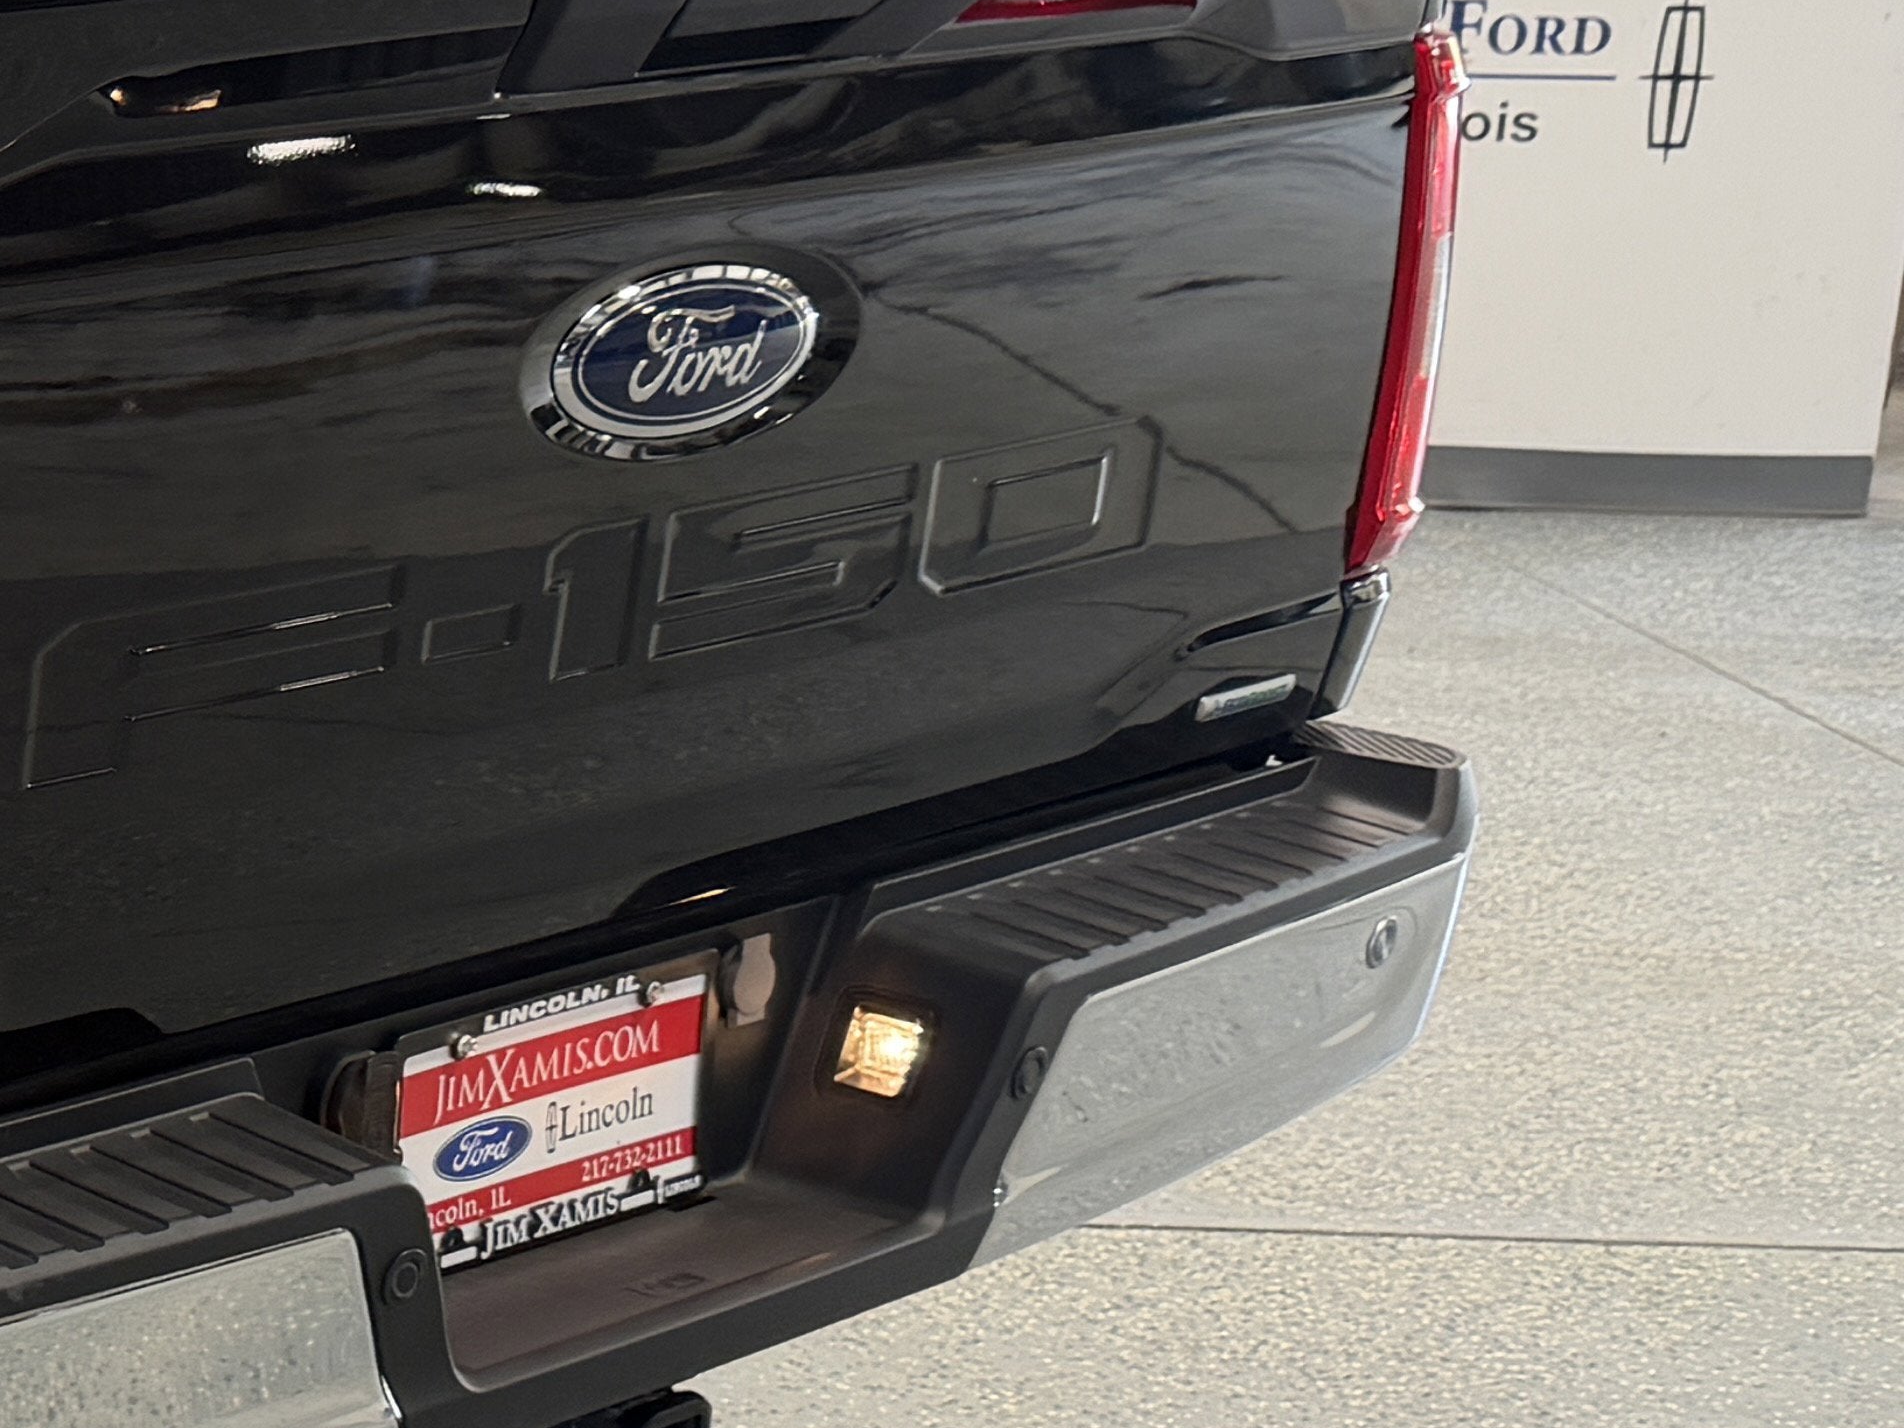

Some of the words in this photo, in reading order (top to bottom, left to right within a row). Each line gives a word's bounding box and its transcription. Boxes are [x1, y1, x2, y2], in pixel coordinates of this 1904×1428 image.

[628, 303, 768, 403] Ford
[23, 417, 1162, 791] F-150
[556, 1086, 655, 1142] Lincoln
[452, 1128, 510, 1172] Ford
[580, 1135, 685, 1183] 217-732-2111
[480, 1214, 531, 1260] JIM
[533, 1190, 620, 1240] XAMIS
[490, 1185, 512, 1210] IL
